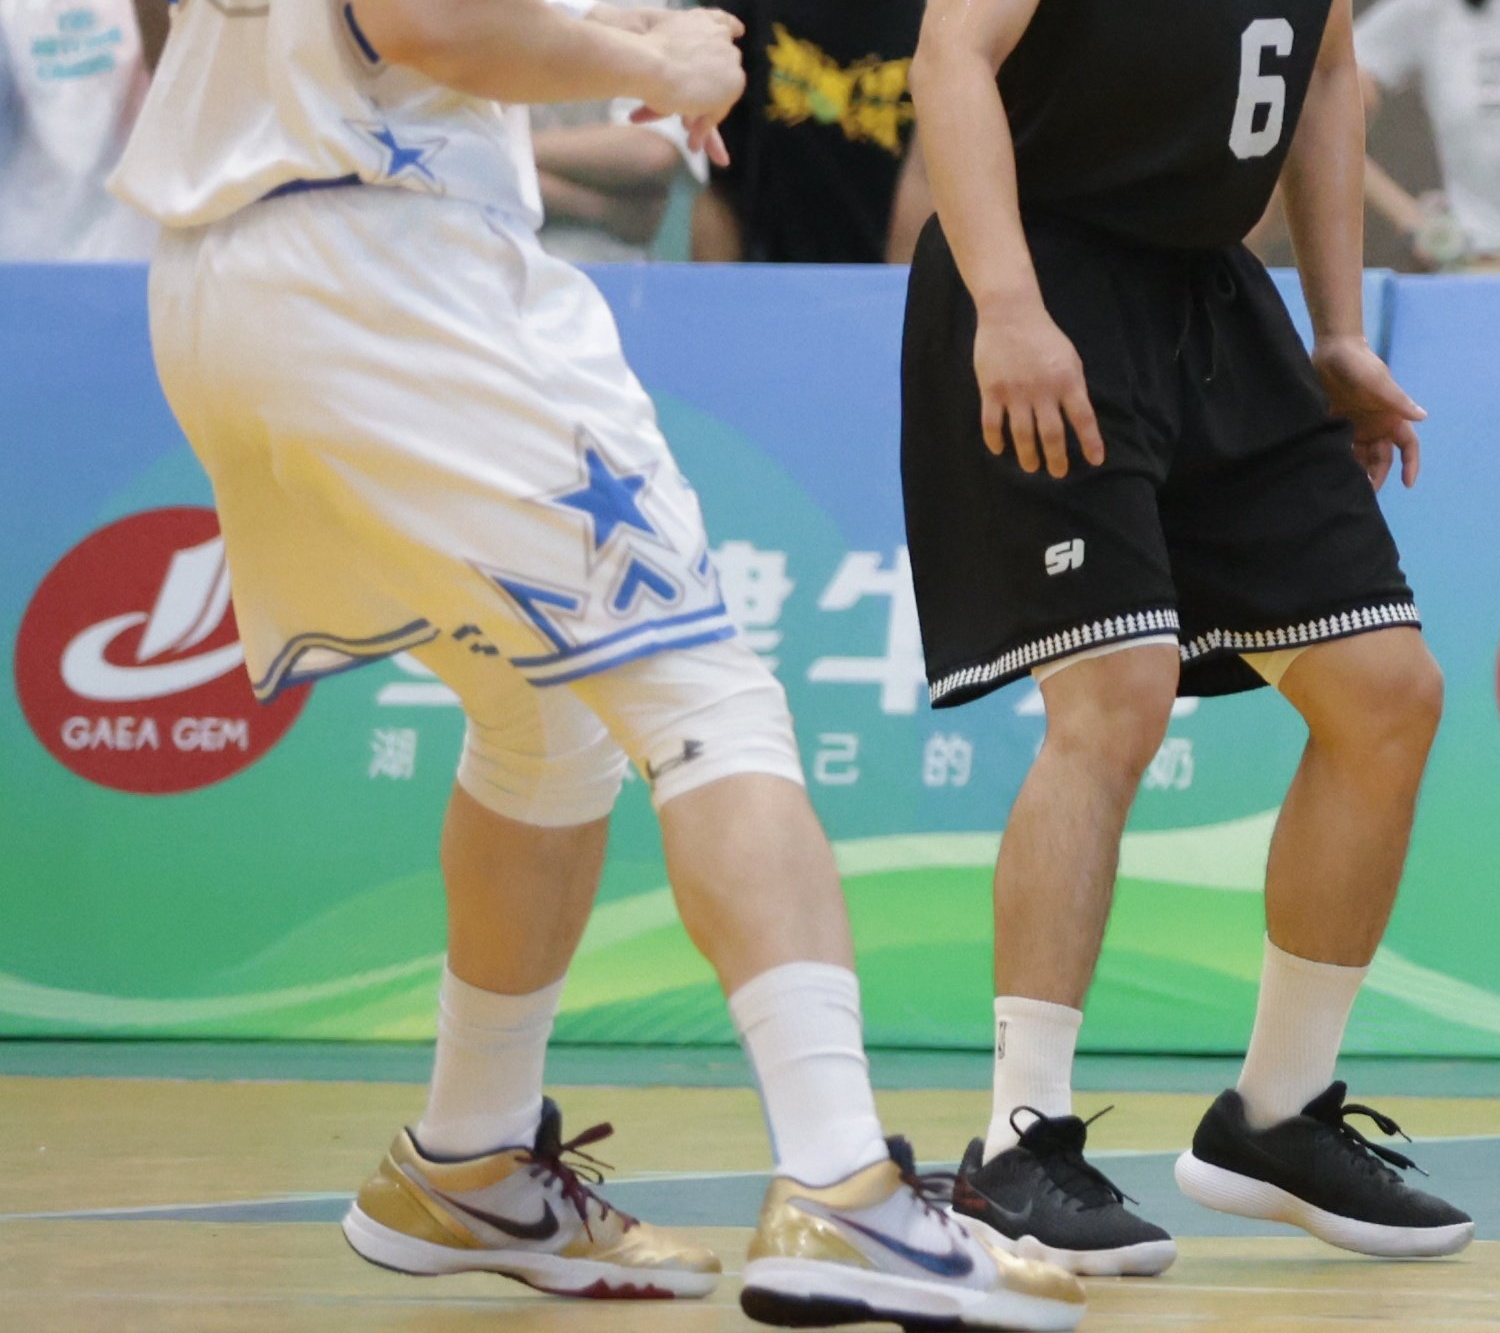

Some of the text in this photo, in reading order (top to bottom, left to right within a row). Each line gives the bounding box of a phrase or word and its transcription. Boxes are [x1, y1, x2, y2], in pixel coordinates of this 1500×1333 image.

[1228, 17, 1295, 160] 6
[60, 715, 249, 752] GAEA GEM
